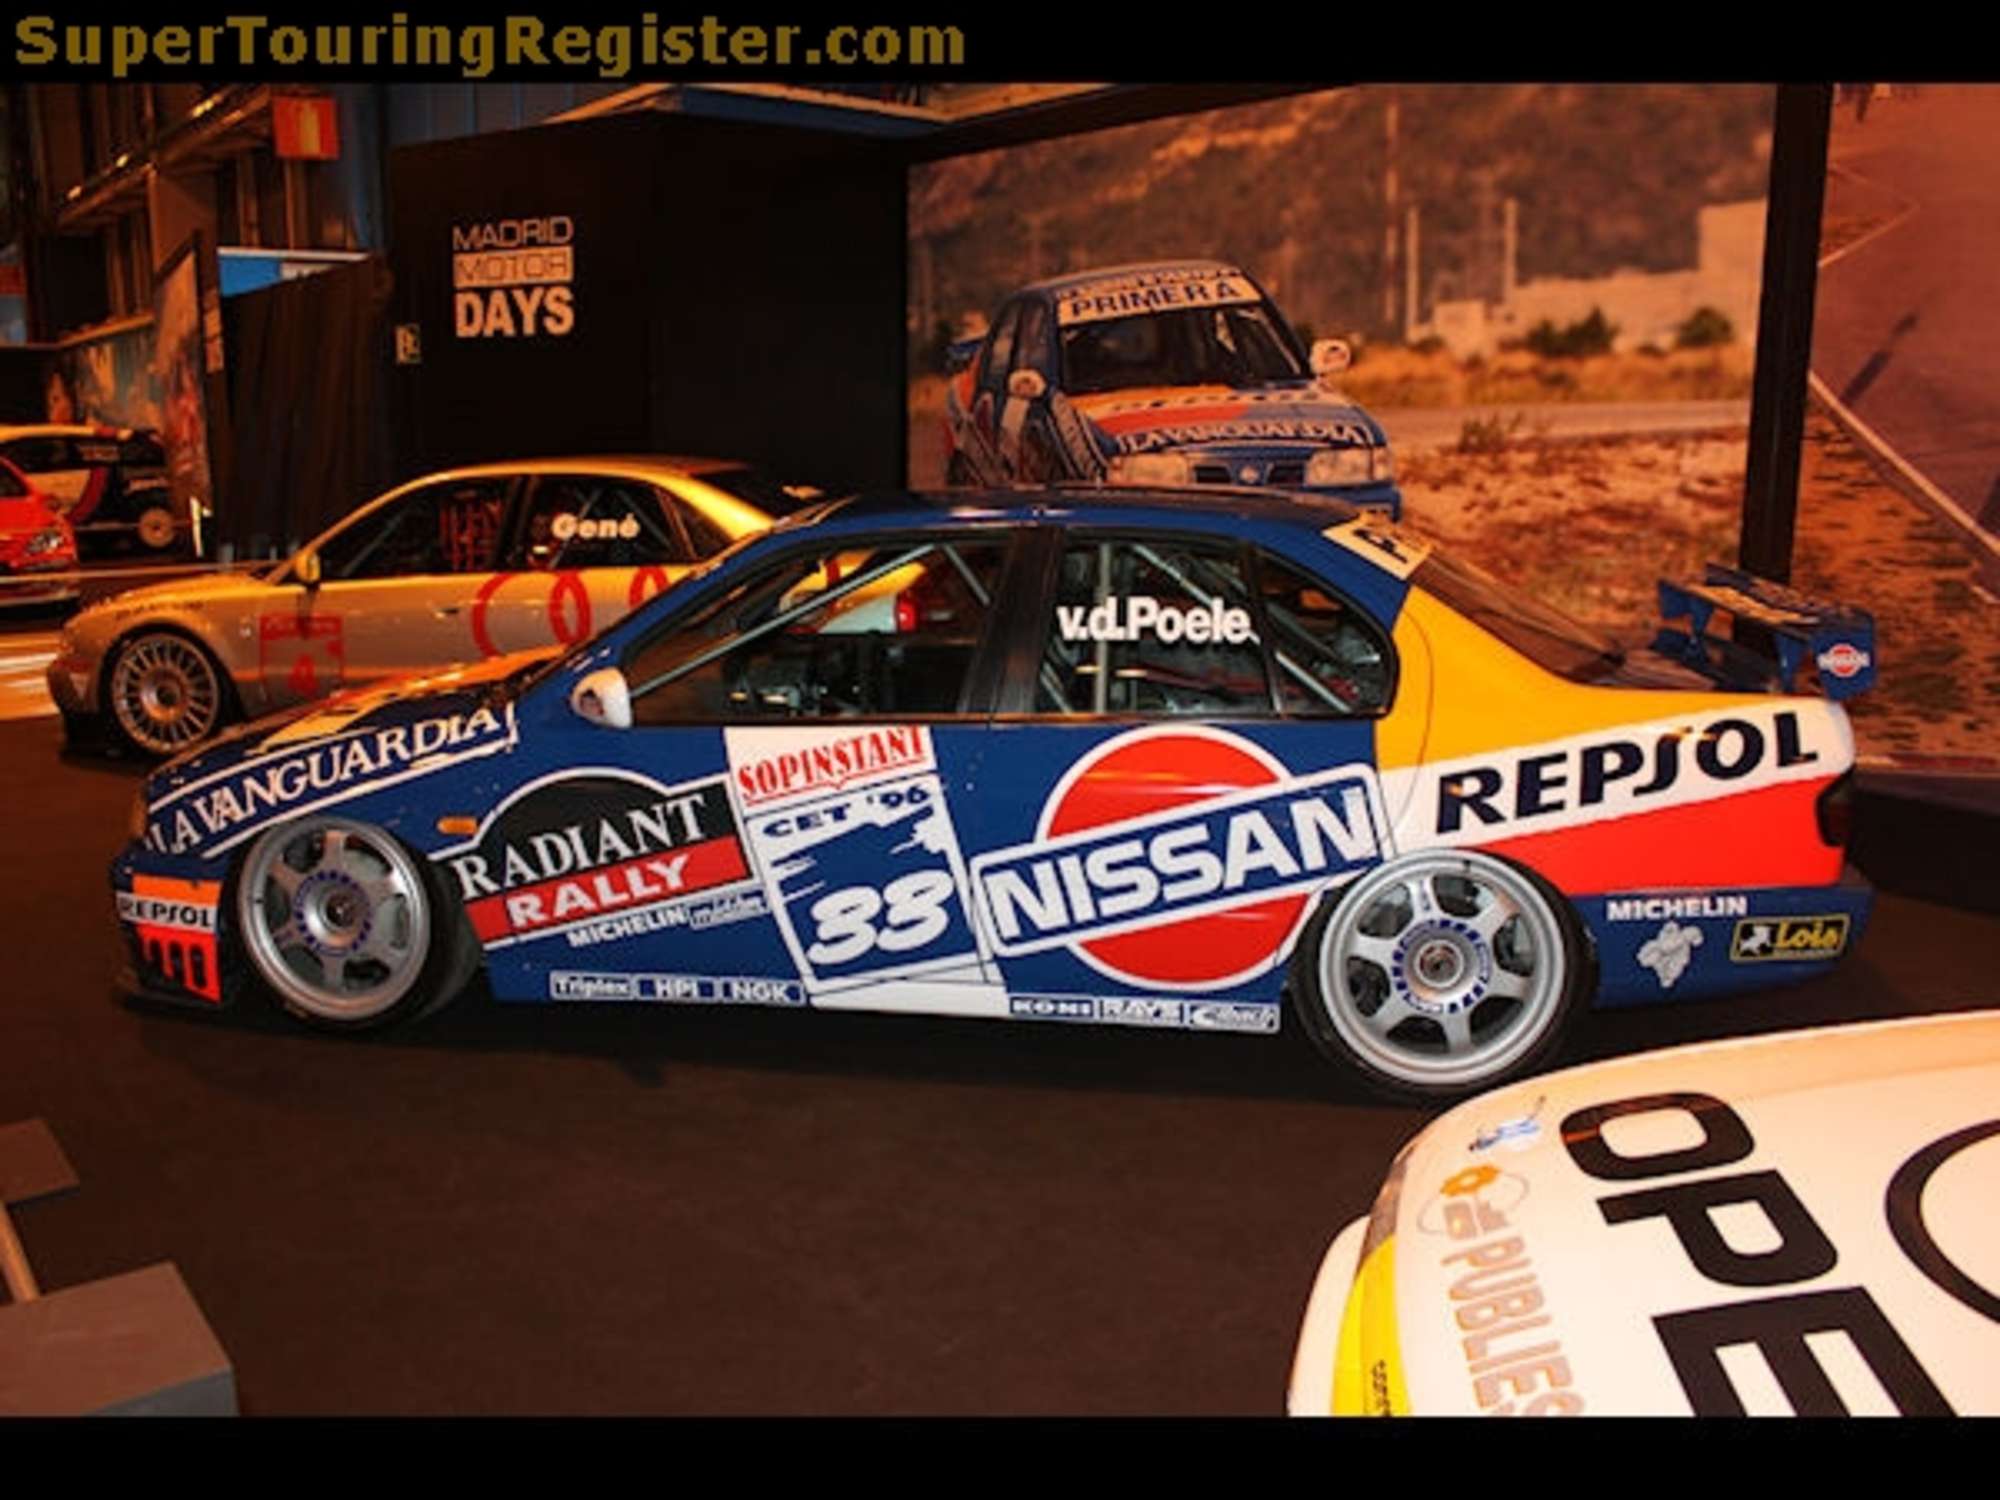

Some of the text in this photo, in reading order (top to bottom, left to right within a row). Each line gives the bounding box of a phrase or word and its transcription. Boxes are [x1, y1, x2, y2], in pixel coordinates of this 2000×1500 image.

[453, 216, 574, 250] MADRID
[457, 252, 568, 282] MOTOR
[456, 286, 575, 338] DAYS
[1071, 280, 1241, 318] PRIMERA
[550, 513, 640, 541] Gené
[1056, 595, 1252, 644] v.d.Poele
[192, 706, 502, 833] VANGUARDIA
[738, 726, 926, 800] SOPINSTANT
[1436, 711, 1819, 836] REPSOL
[762, 785, 931, 838] CET '96
[451, 794, 706, 899] RADIANT
[984, 786, 1379, 940] NISSAN
[120, 896, 212, 928] REPSOL
[505, 853, 690, 929] RALLY
[1606, 895, 1748, 922] MICHELIN
[565, 901, 688, 948] MICHELIN
[806, 869, 956, 965] 33
[1774, 920, 1838, 953] Lois
[555, 975, 631, 997] Triplex
[732, 980, 789, 1002] NGK
[1011, 1000, 1092, 1017] KONI
